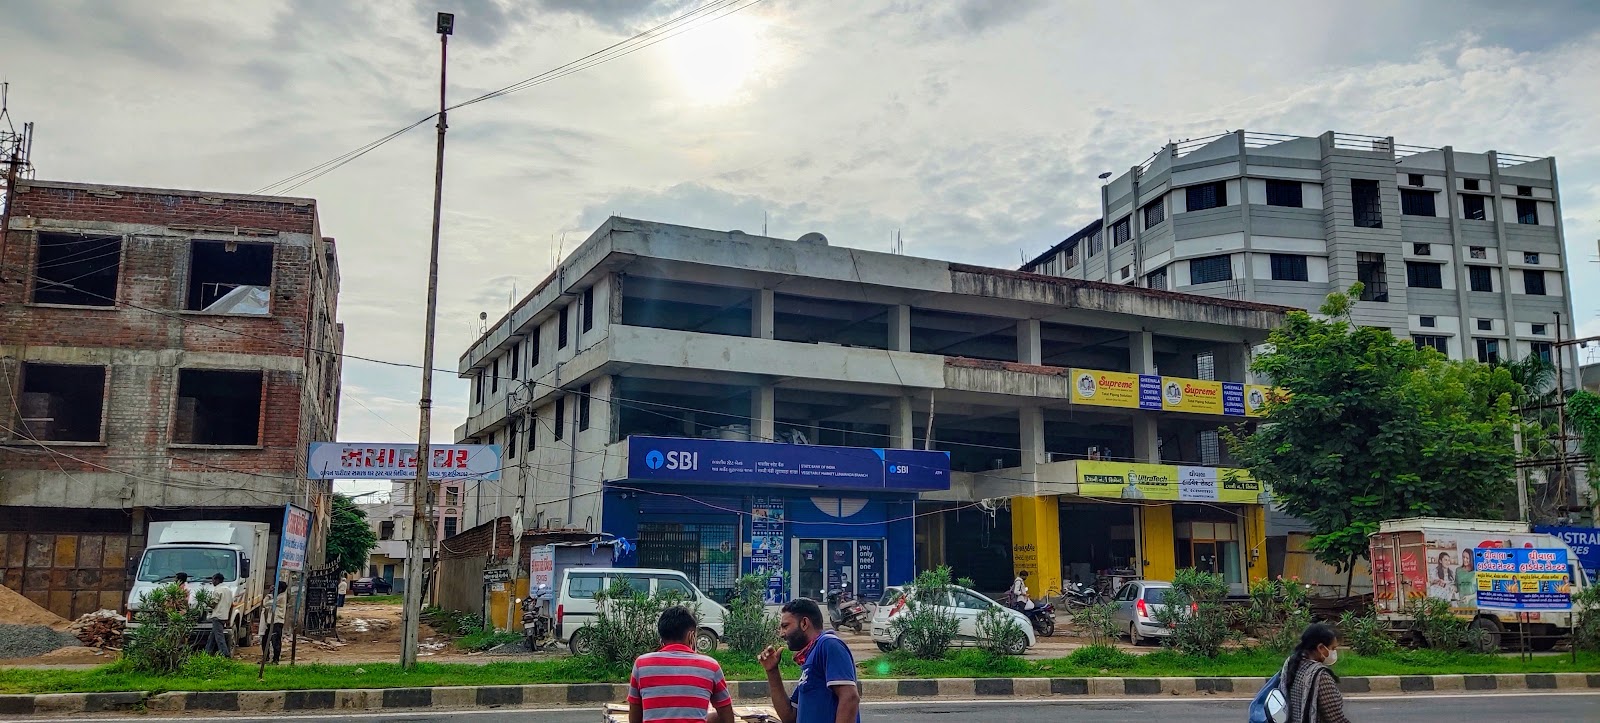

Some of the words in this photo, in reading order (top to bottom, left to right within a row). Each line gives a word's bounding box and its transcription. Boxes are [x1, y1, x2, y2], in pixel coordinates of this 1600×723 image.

[1099, 376, 1133, 391] Supreme
[1184, 384, 1217, 398] Supreme
[666, 451, 698, 471] SBI
[897, 465, 908, 474] SBI
[1138, 474, 1168, 482] UltraTech
[859, 544, 871, 552] you
[1484, 549, 1507, 560] ઘીવાલા
[1528, 550, 1556, 560] ઘીવાલા
[1477, 559, 1497, 571] હાર્ડવેર
[1497, 560, 1516, 570] સેન્ટર
[1520, 560, 1544, 572] હાર્ડવેર
[1545, 560, 1566, 571] સેન્ટર
